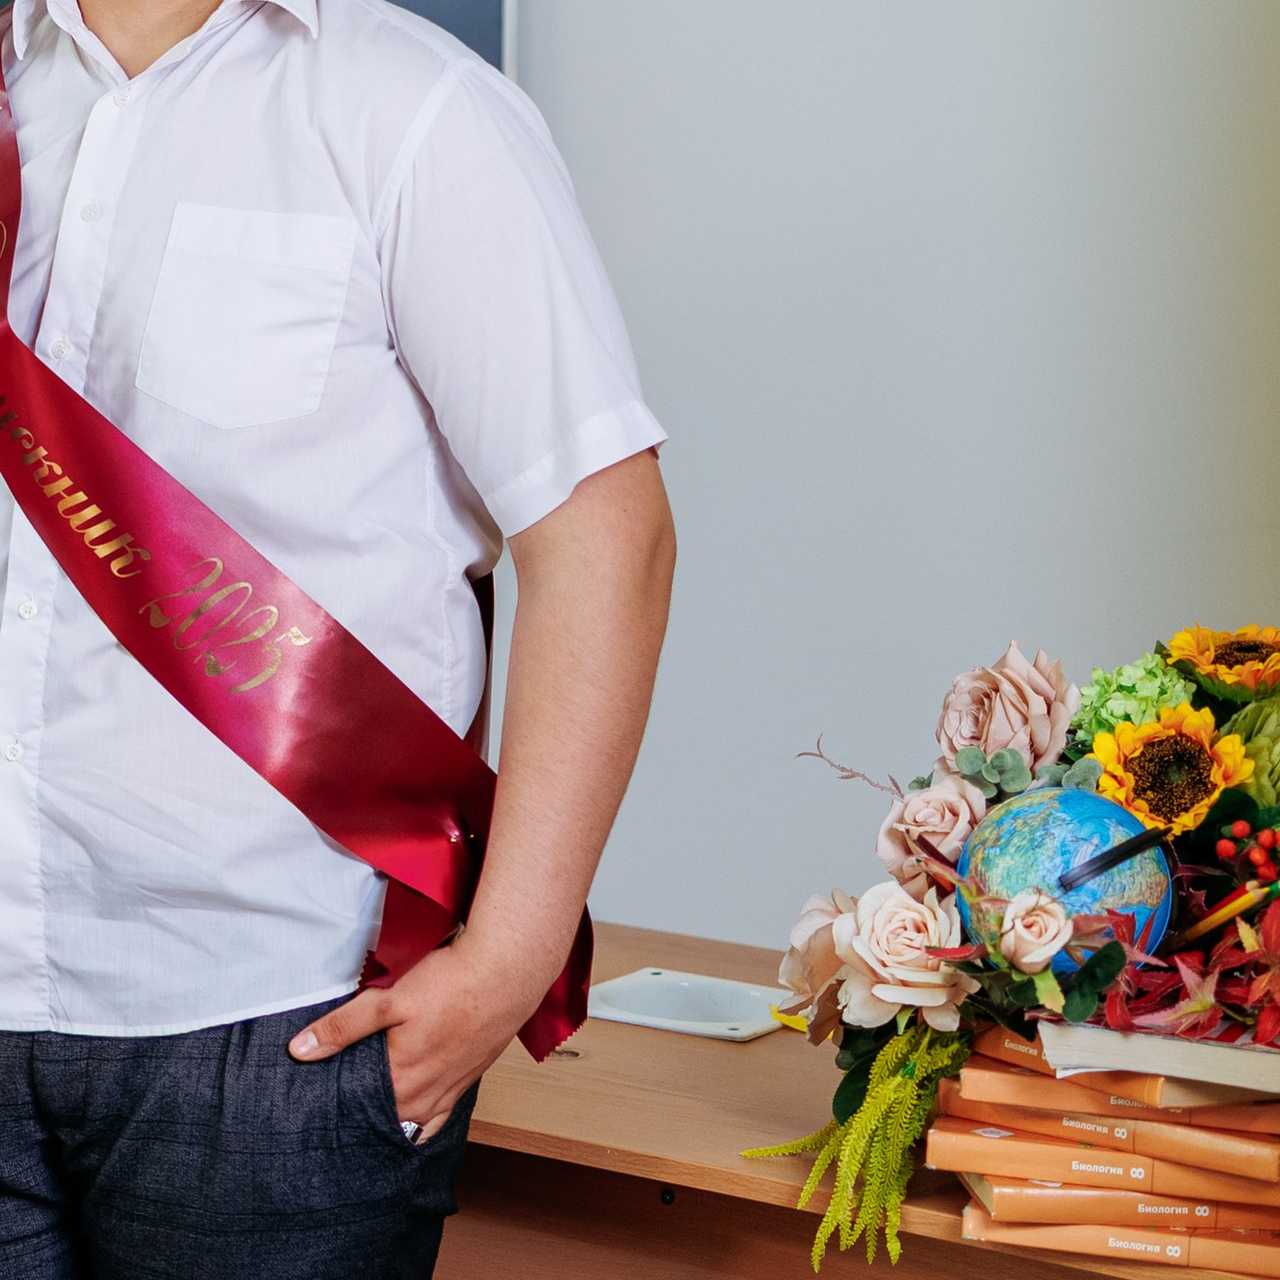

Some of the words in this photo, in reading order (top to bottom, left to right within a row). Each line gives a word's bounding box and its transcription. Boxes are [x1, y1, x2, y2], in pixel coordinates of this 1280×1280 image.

[138, 557, 313, 693] 2025
[1004, 1039, 1038, 1057] Биология
[1062, 1117, 1109, 1134] Биология
[1114, 1127, 1127, 1139] 8
[1072, 1161, 1123, 1175] Биология
[1130, 1167, 1145, 1179] 8
[1137, 1204, 1188, 1214] Биология
[1195, 1205, 1209, 1217] 8
[1108, 1237, 1160, 1253] Биология
[1166, 1245, 1181, 1257] 8
